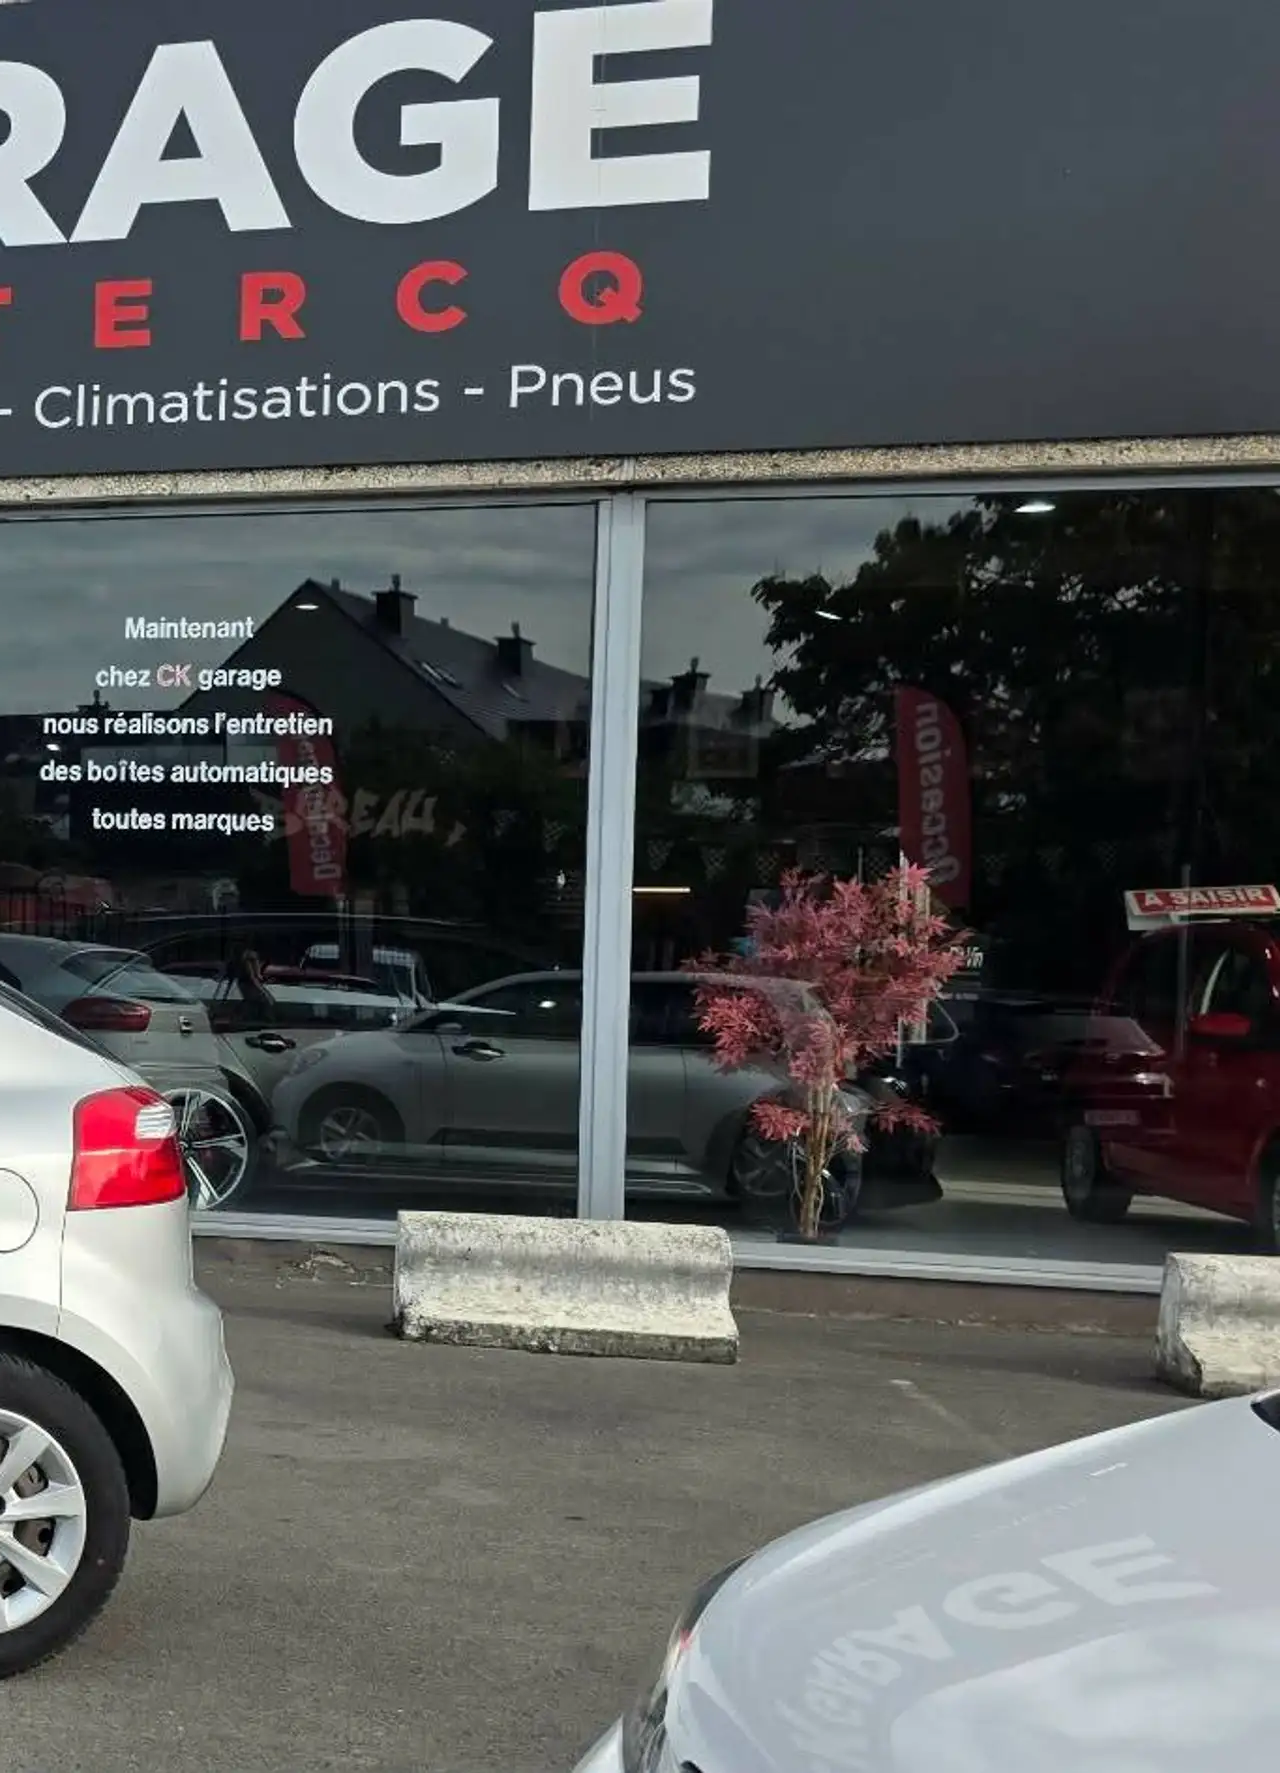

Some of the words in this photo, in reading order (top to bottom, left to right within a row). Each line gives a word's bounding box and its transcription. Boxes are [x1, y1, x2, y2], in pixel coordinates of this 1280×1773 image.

[34, 372, 441, 429] Climatisations
[509, 363, 698, 408] Pneus
[125, 617, 255, 640] Maintenant
[95, 666, 151, 688] chez
[156, 664, 192, 688] CK
[198, 668, 282, 691] garage
[43, 716, 99, 736] nous
[104, 712, 210, 736] réalisons
[214, 711, 334, 736] l'entretien
[40, 760, 82, 783] des
[87, 760, 165, 784] boîtes
[170, 761, 334, 789] automatiques
[91, 808, 167, 831] toutes
[172, 812, 275, 836] marques
[1168, 887, 1270, 905] SAISIR
